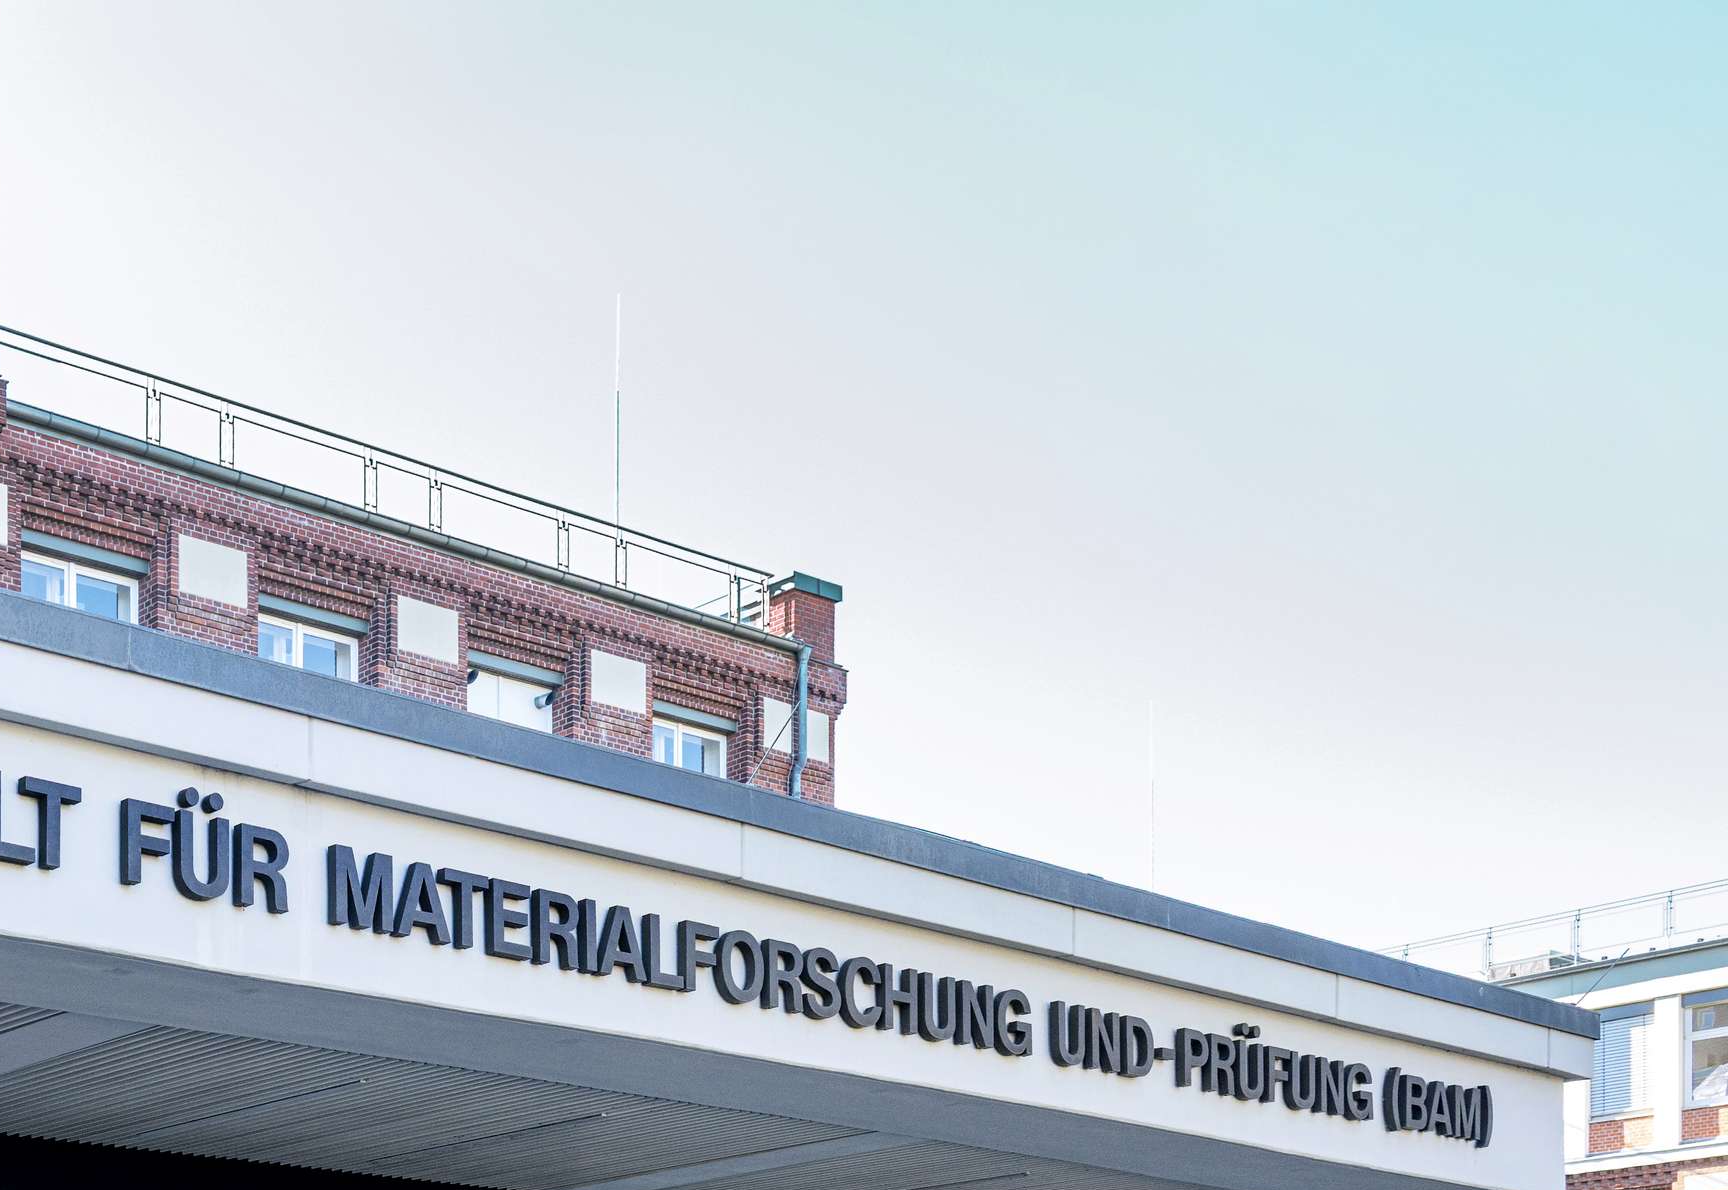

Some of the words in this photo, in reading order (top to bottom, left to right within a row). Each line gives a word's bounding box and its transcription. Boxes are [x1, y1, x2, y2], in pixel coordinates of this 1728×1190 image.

[119, 786, 289, 914] FÜR
[327, 844, 1033, 1057] MATERIALFORSCHUNG
[1382, 1066, 1494, 1148] (BAM)
